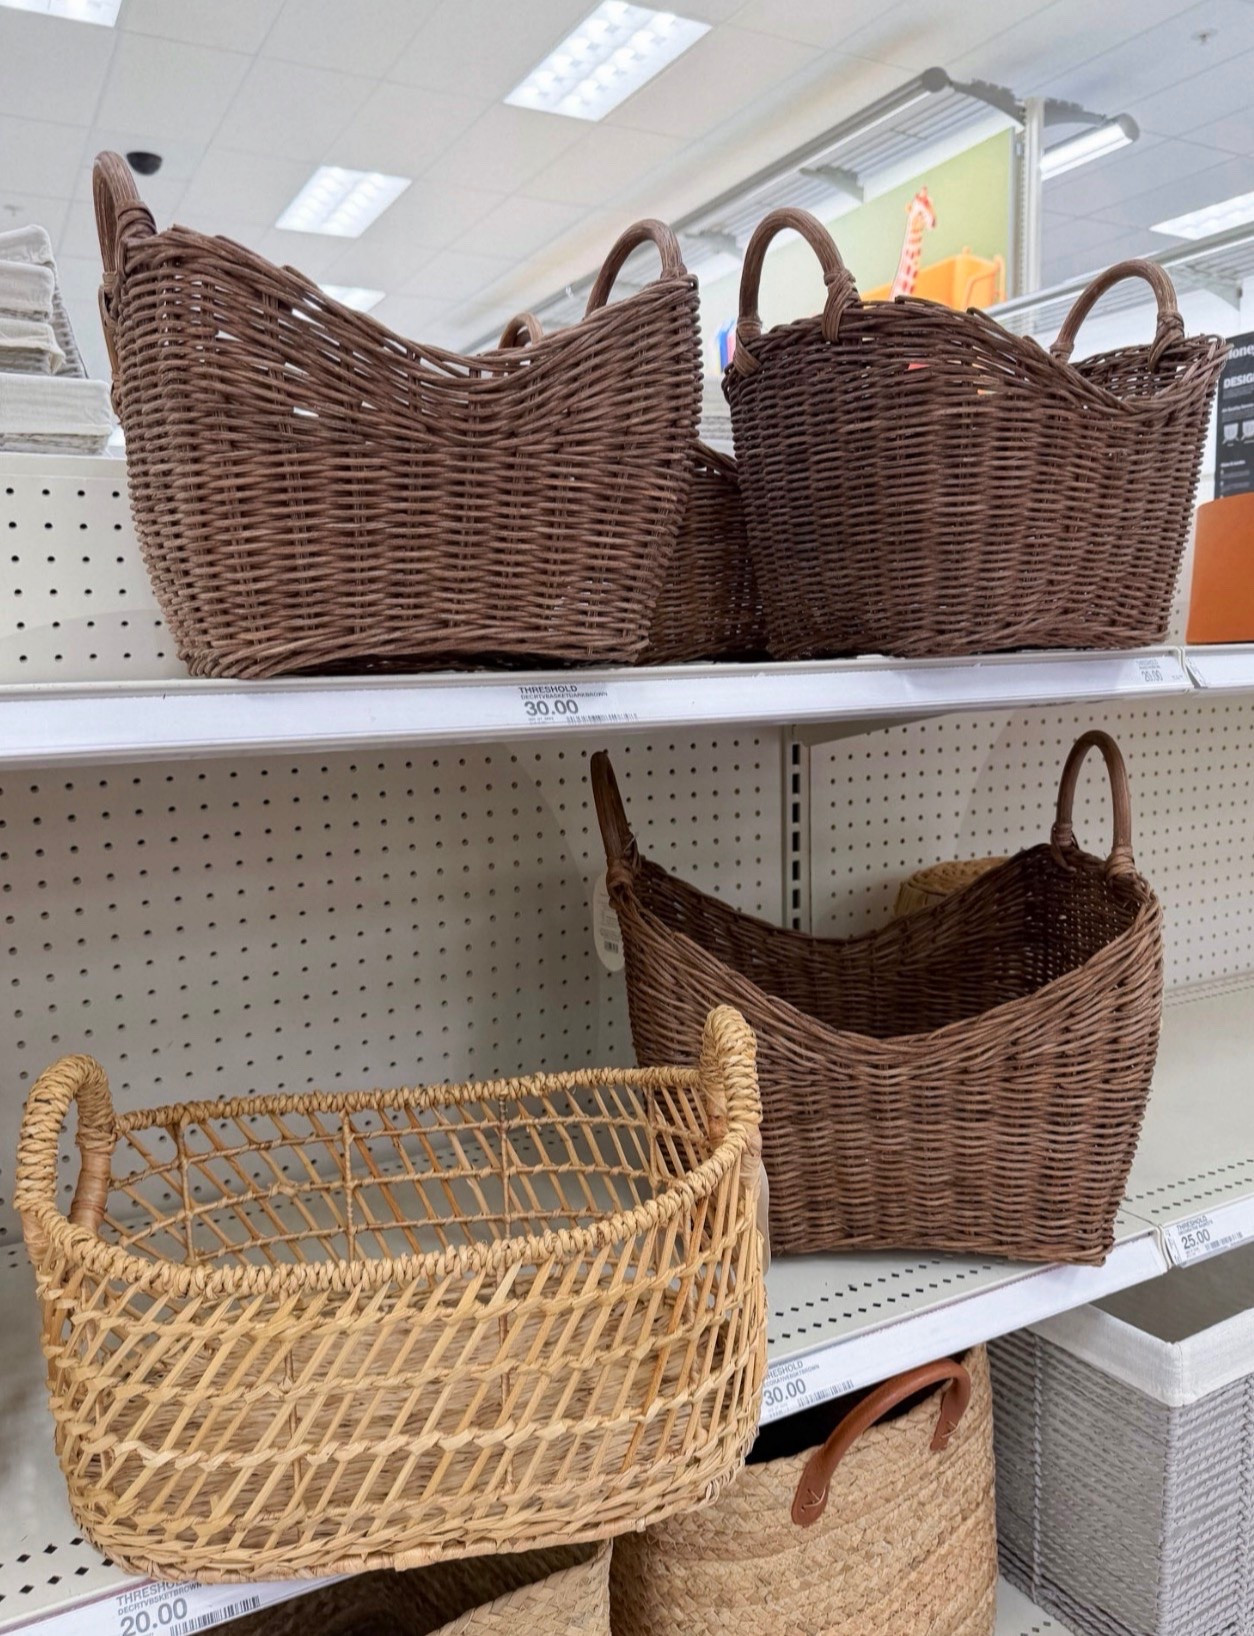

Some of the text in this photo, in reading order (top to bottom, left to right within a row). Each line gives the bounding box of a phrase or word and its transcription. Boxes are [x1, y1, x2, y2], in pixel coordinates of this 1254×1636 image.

[519, 685, 577, 694] THRESHOLD
[524, 699, 579, 716] 30.00
[1181, 1228, 1210, 1249] 25.00
[763, 1378, 806, 1406] 30.00
[120, 1597, 188, 1636] 20.00
